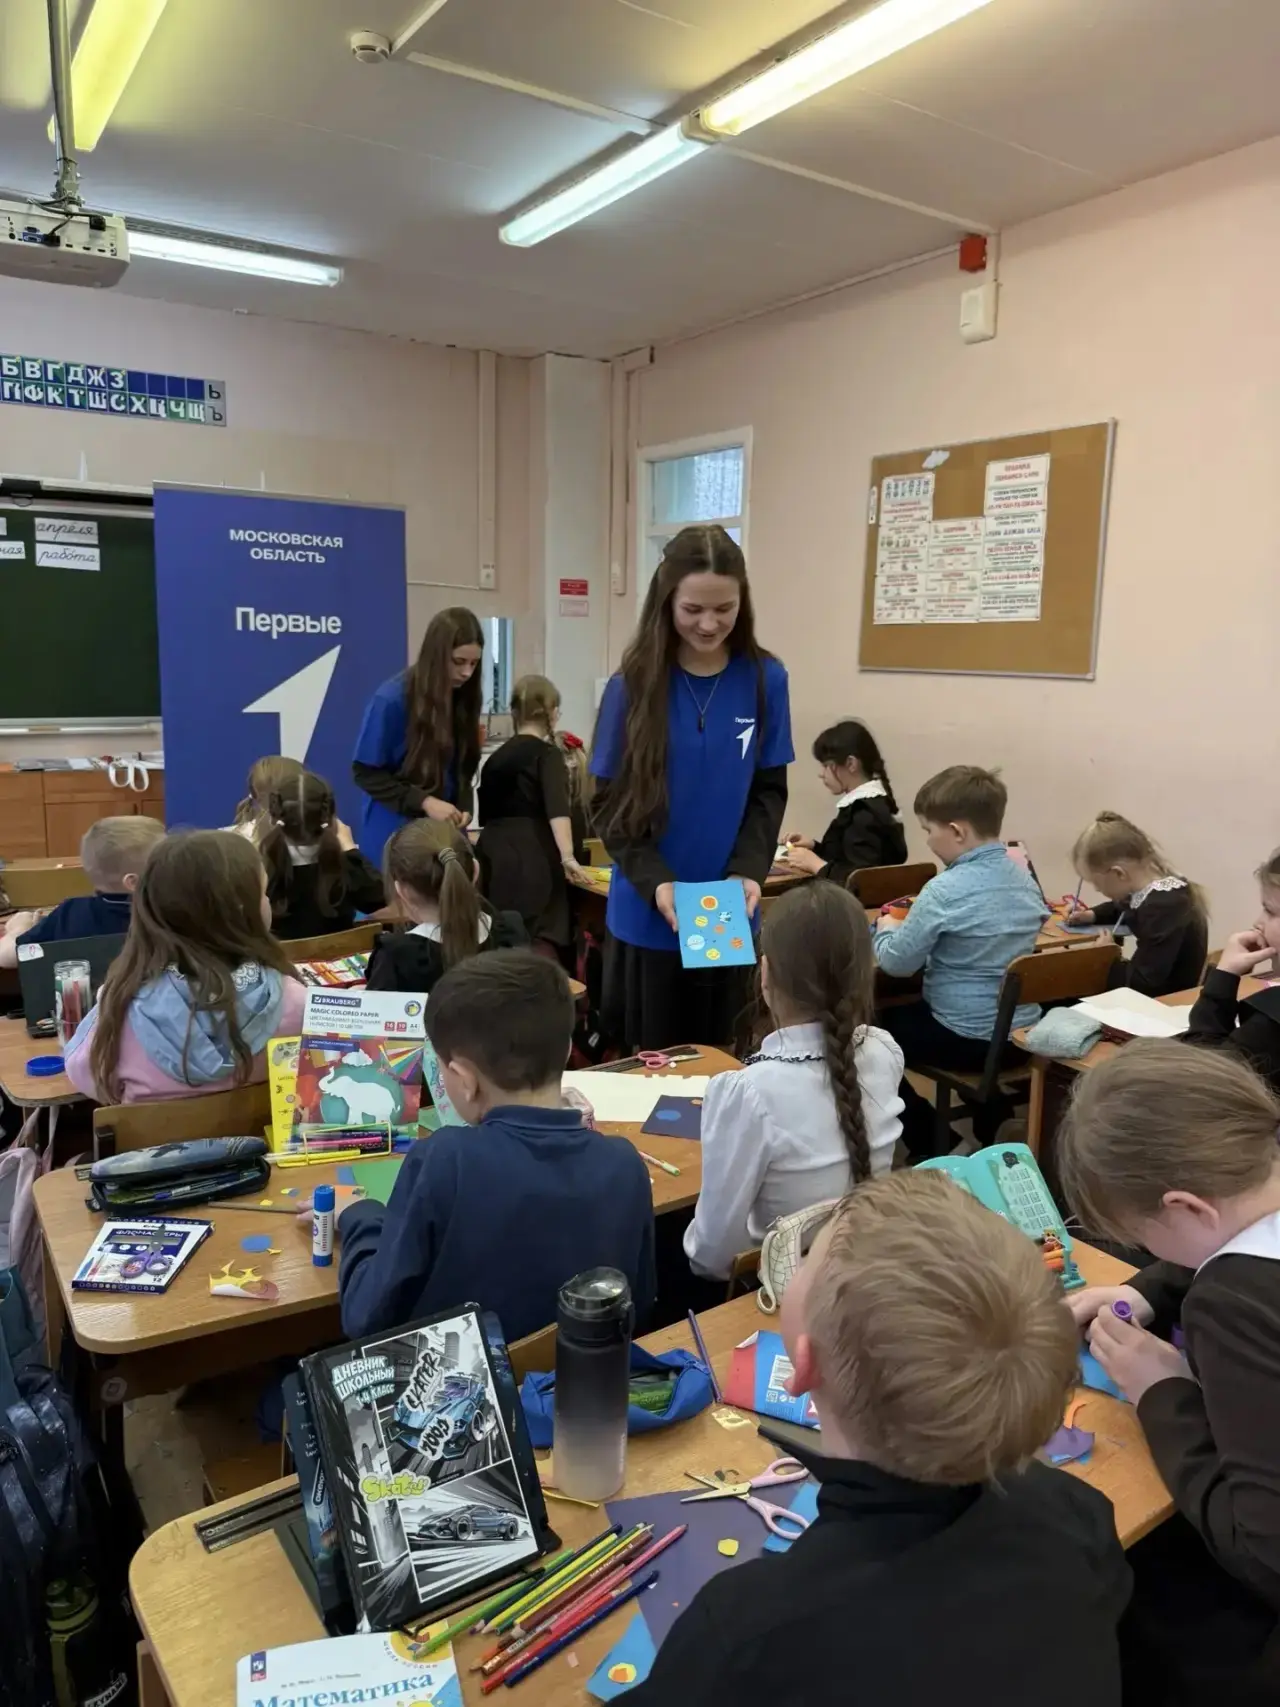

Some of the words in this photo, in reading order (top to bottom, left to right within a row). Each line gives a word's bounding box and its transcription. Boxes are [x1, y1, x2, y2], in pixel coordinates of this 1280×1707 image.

[229, 529, 343, 548] МОСКОВСКАЯ
[250, 547, 326, 563] ОБЛАСТЬ
[236, 606, 342, 639] Первые
[322, 997, 356, 1006] BRAUBERG
[116, 1229, 184, 1238] ФЛОМАСЕРЫ
[332, 1356, 388, 1386] ДНЕВНИК
[336, 1365, 395, 1401] ШКОЛЬНЫЙ
[370, 1384, 396, 1400] КЛАСС
[252, 1674, 435, 1707] Математика
